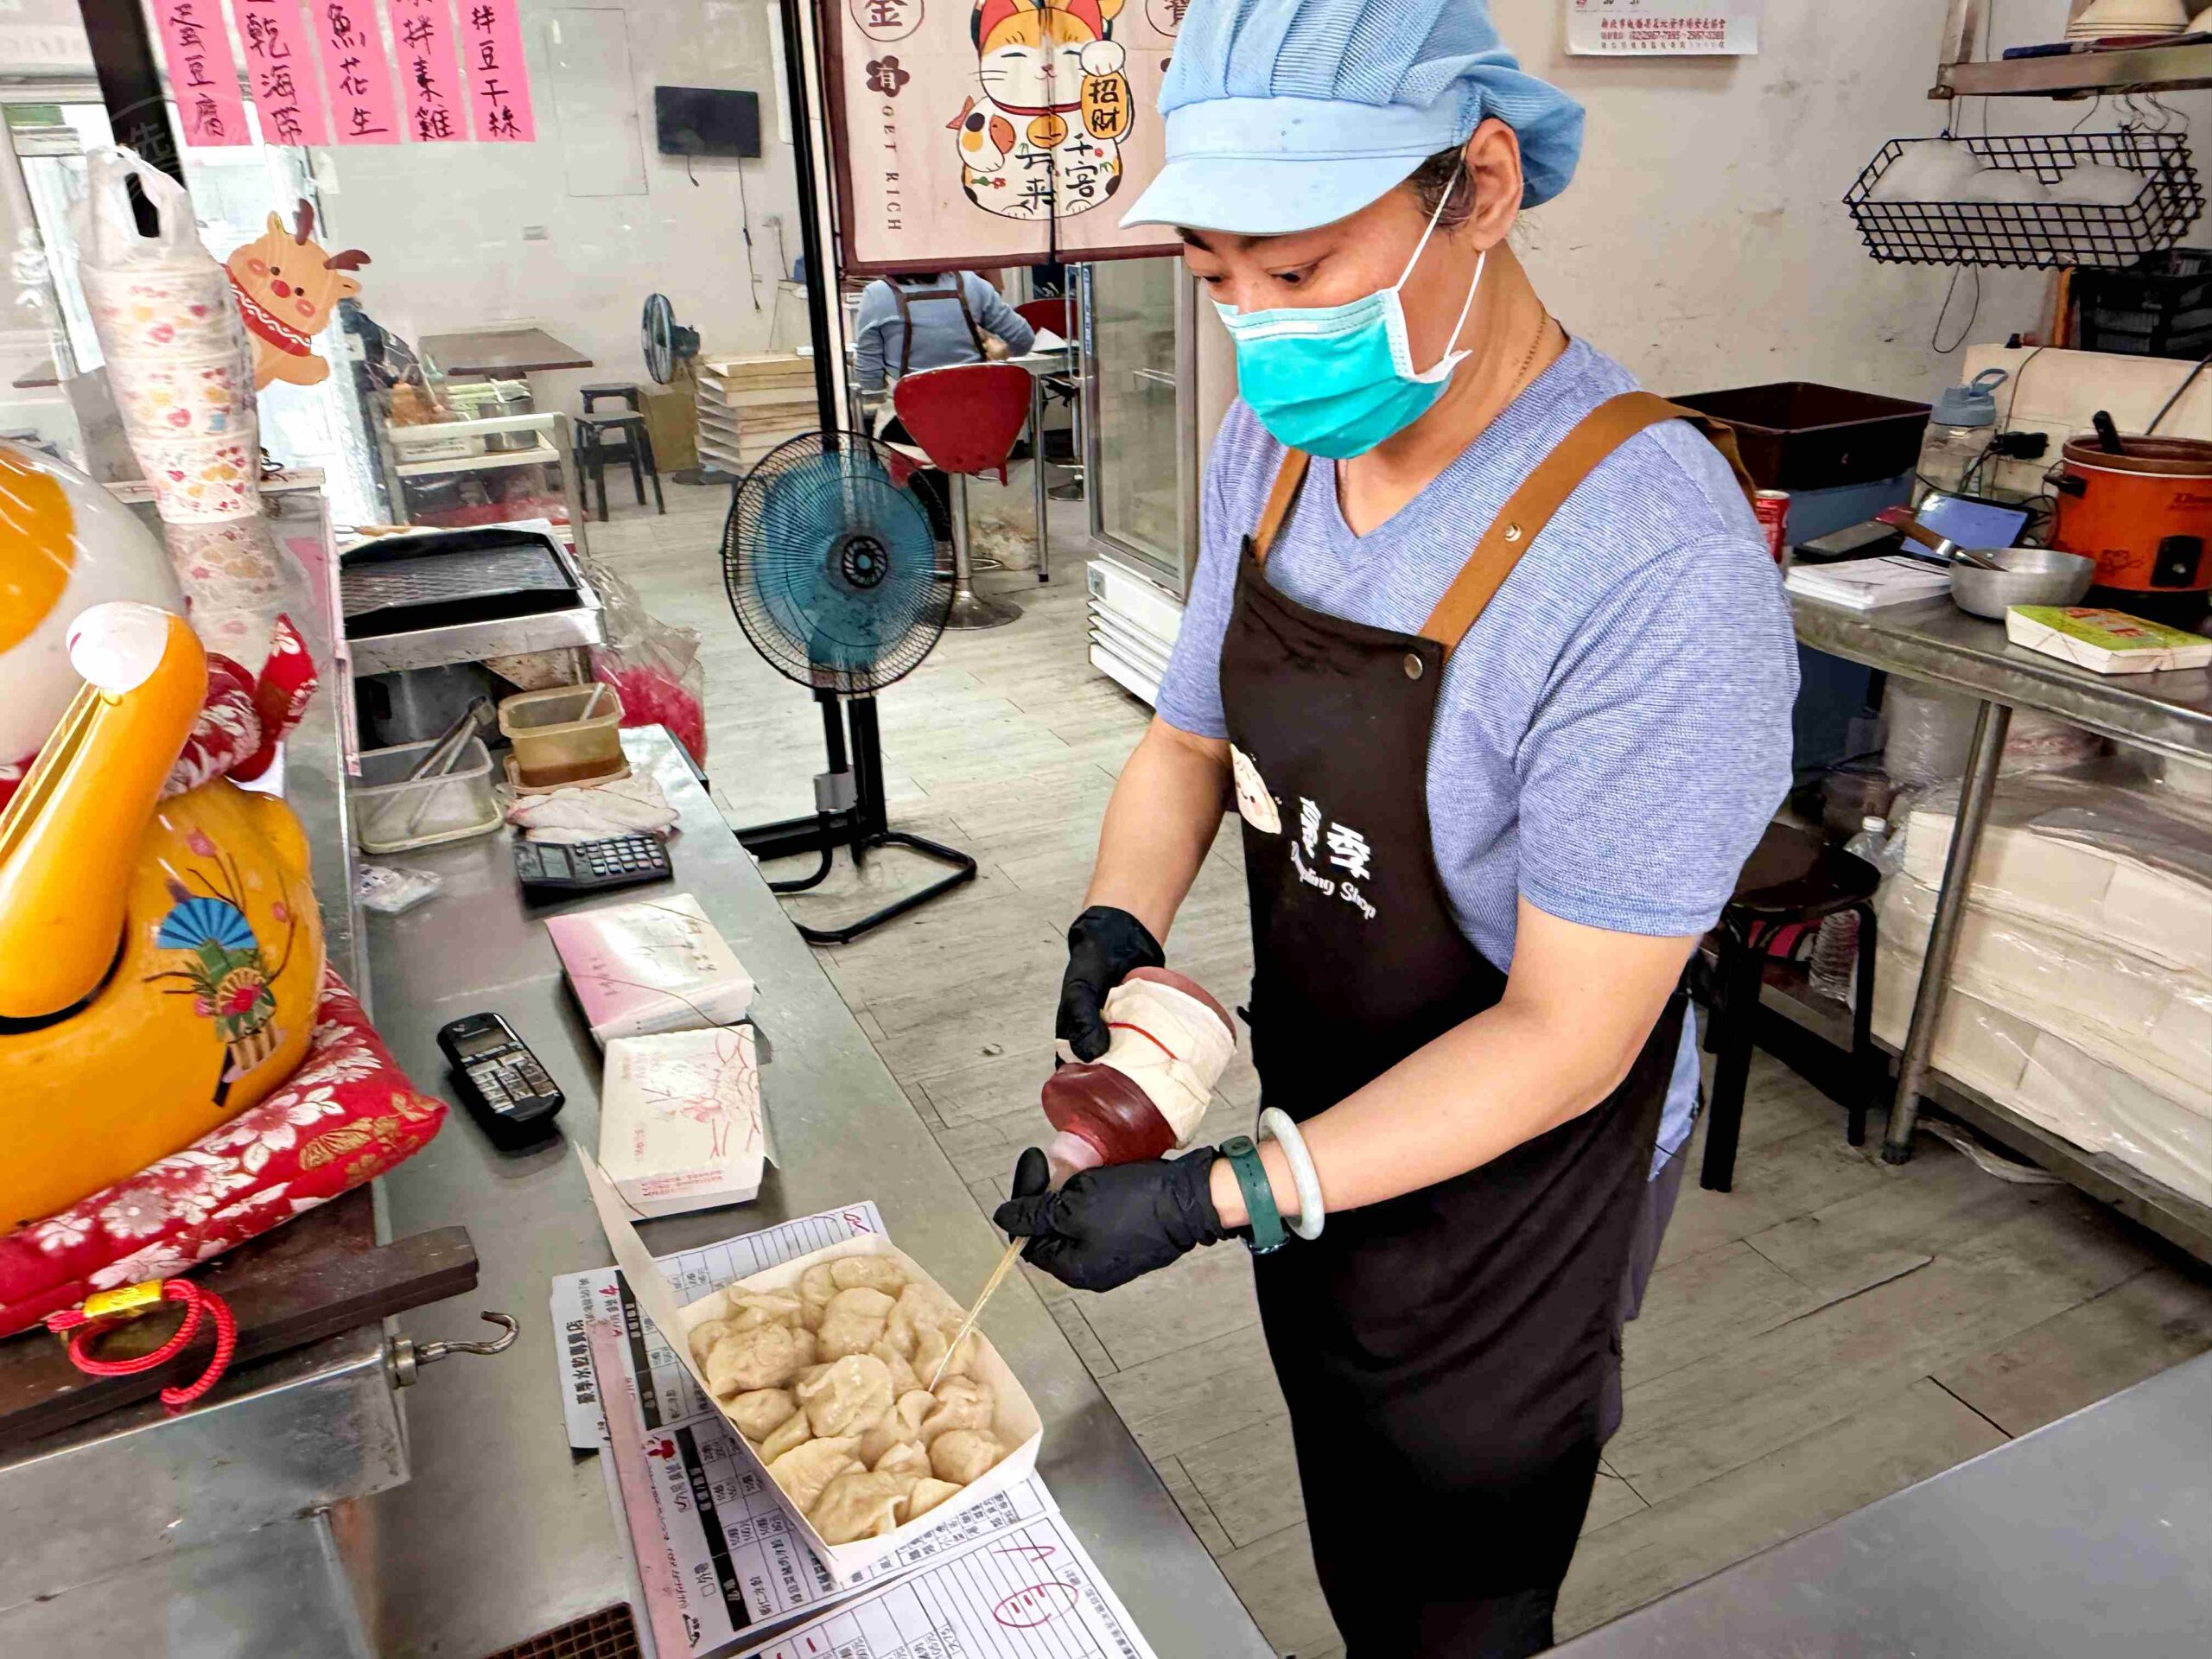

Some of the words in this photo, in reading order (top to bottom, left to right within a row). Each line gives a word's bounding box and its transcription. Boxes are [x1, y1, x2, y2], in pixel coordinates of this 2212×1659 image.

[881, 105, 898, 153] GET
[885, 172, 903, 231] RICH
[1339, 881, 1377, 920] Shop
